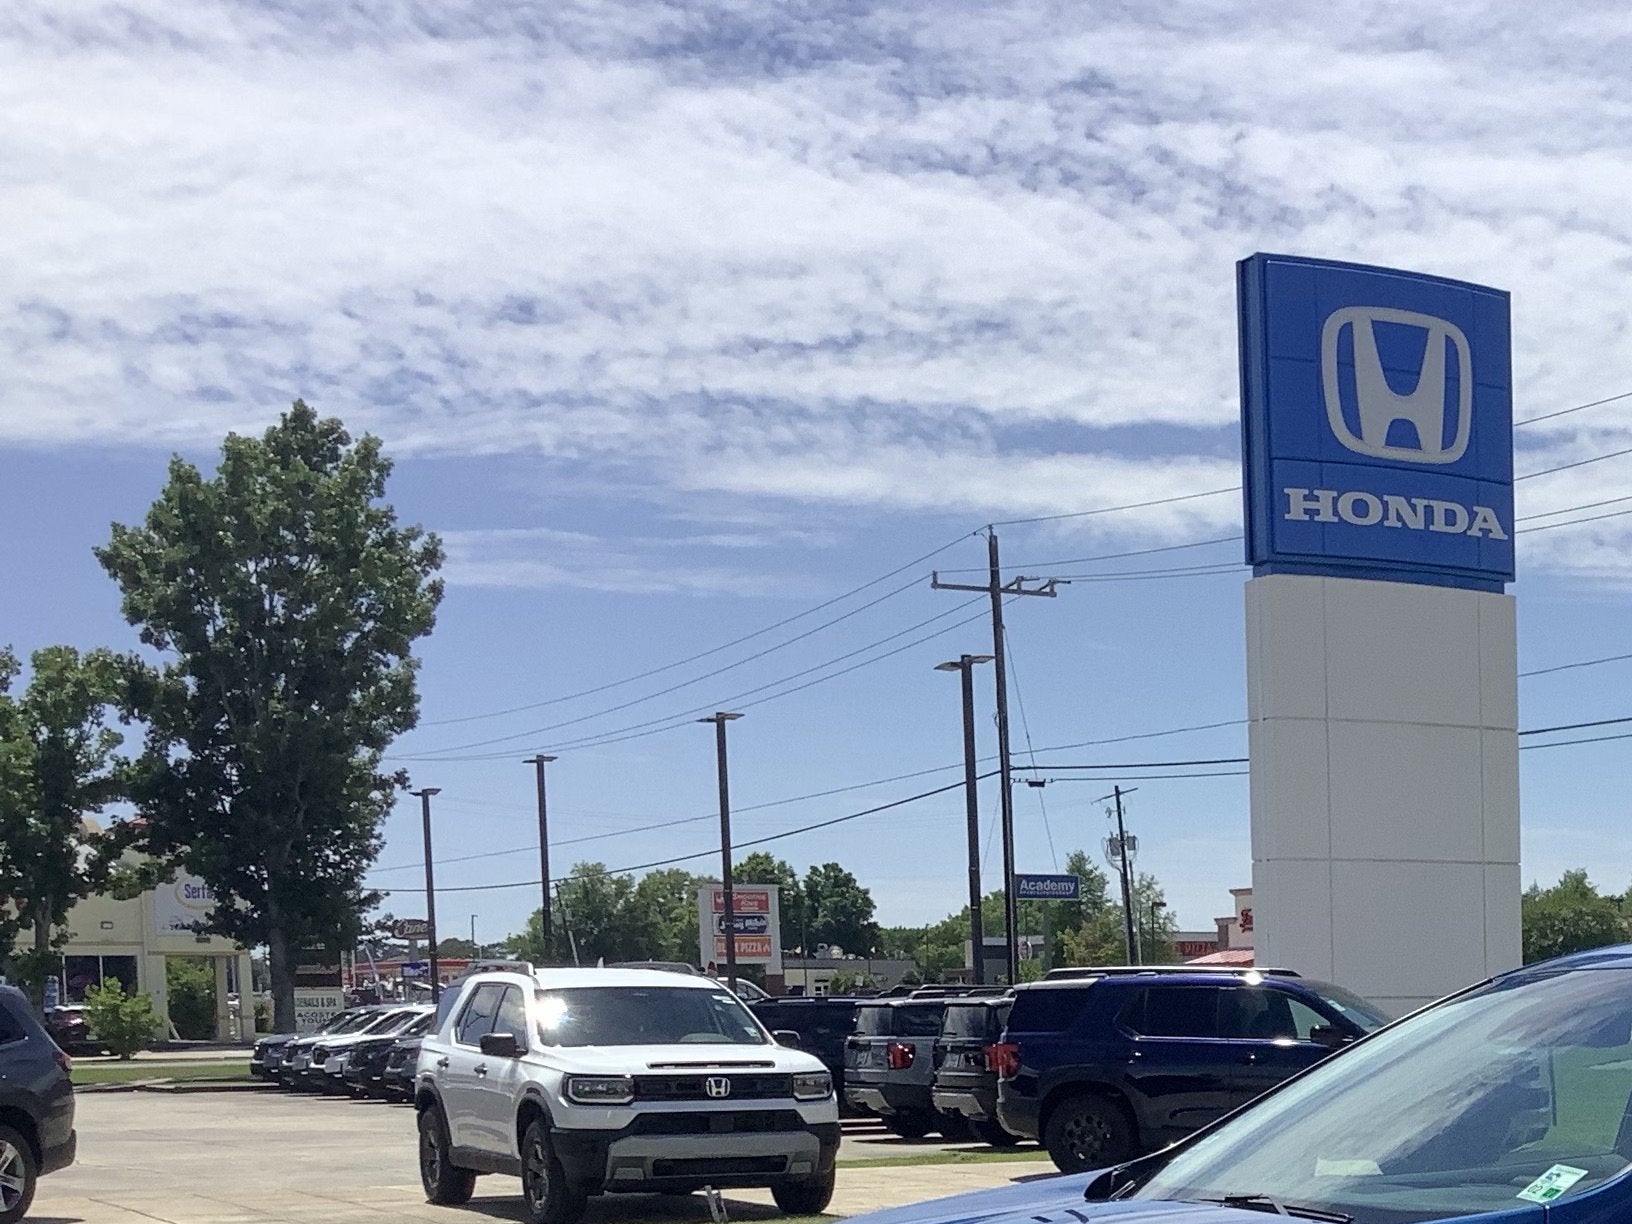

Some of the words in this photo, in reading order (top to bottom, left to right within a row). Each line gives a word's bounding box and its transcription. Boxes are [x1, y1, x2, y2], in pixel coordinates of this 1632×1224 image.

[1282, 487, 1508, 541] HONDA
[1020, 880, 1076, 895] Academy
[394, 921, 429, 938] Cane
